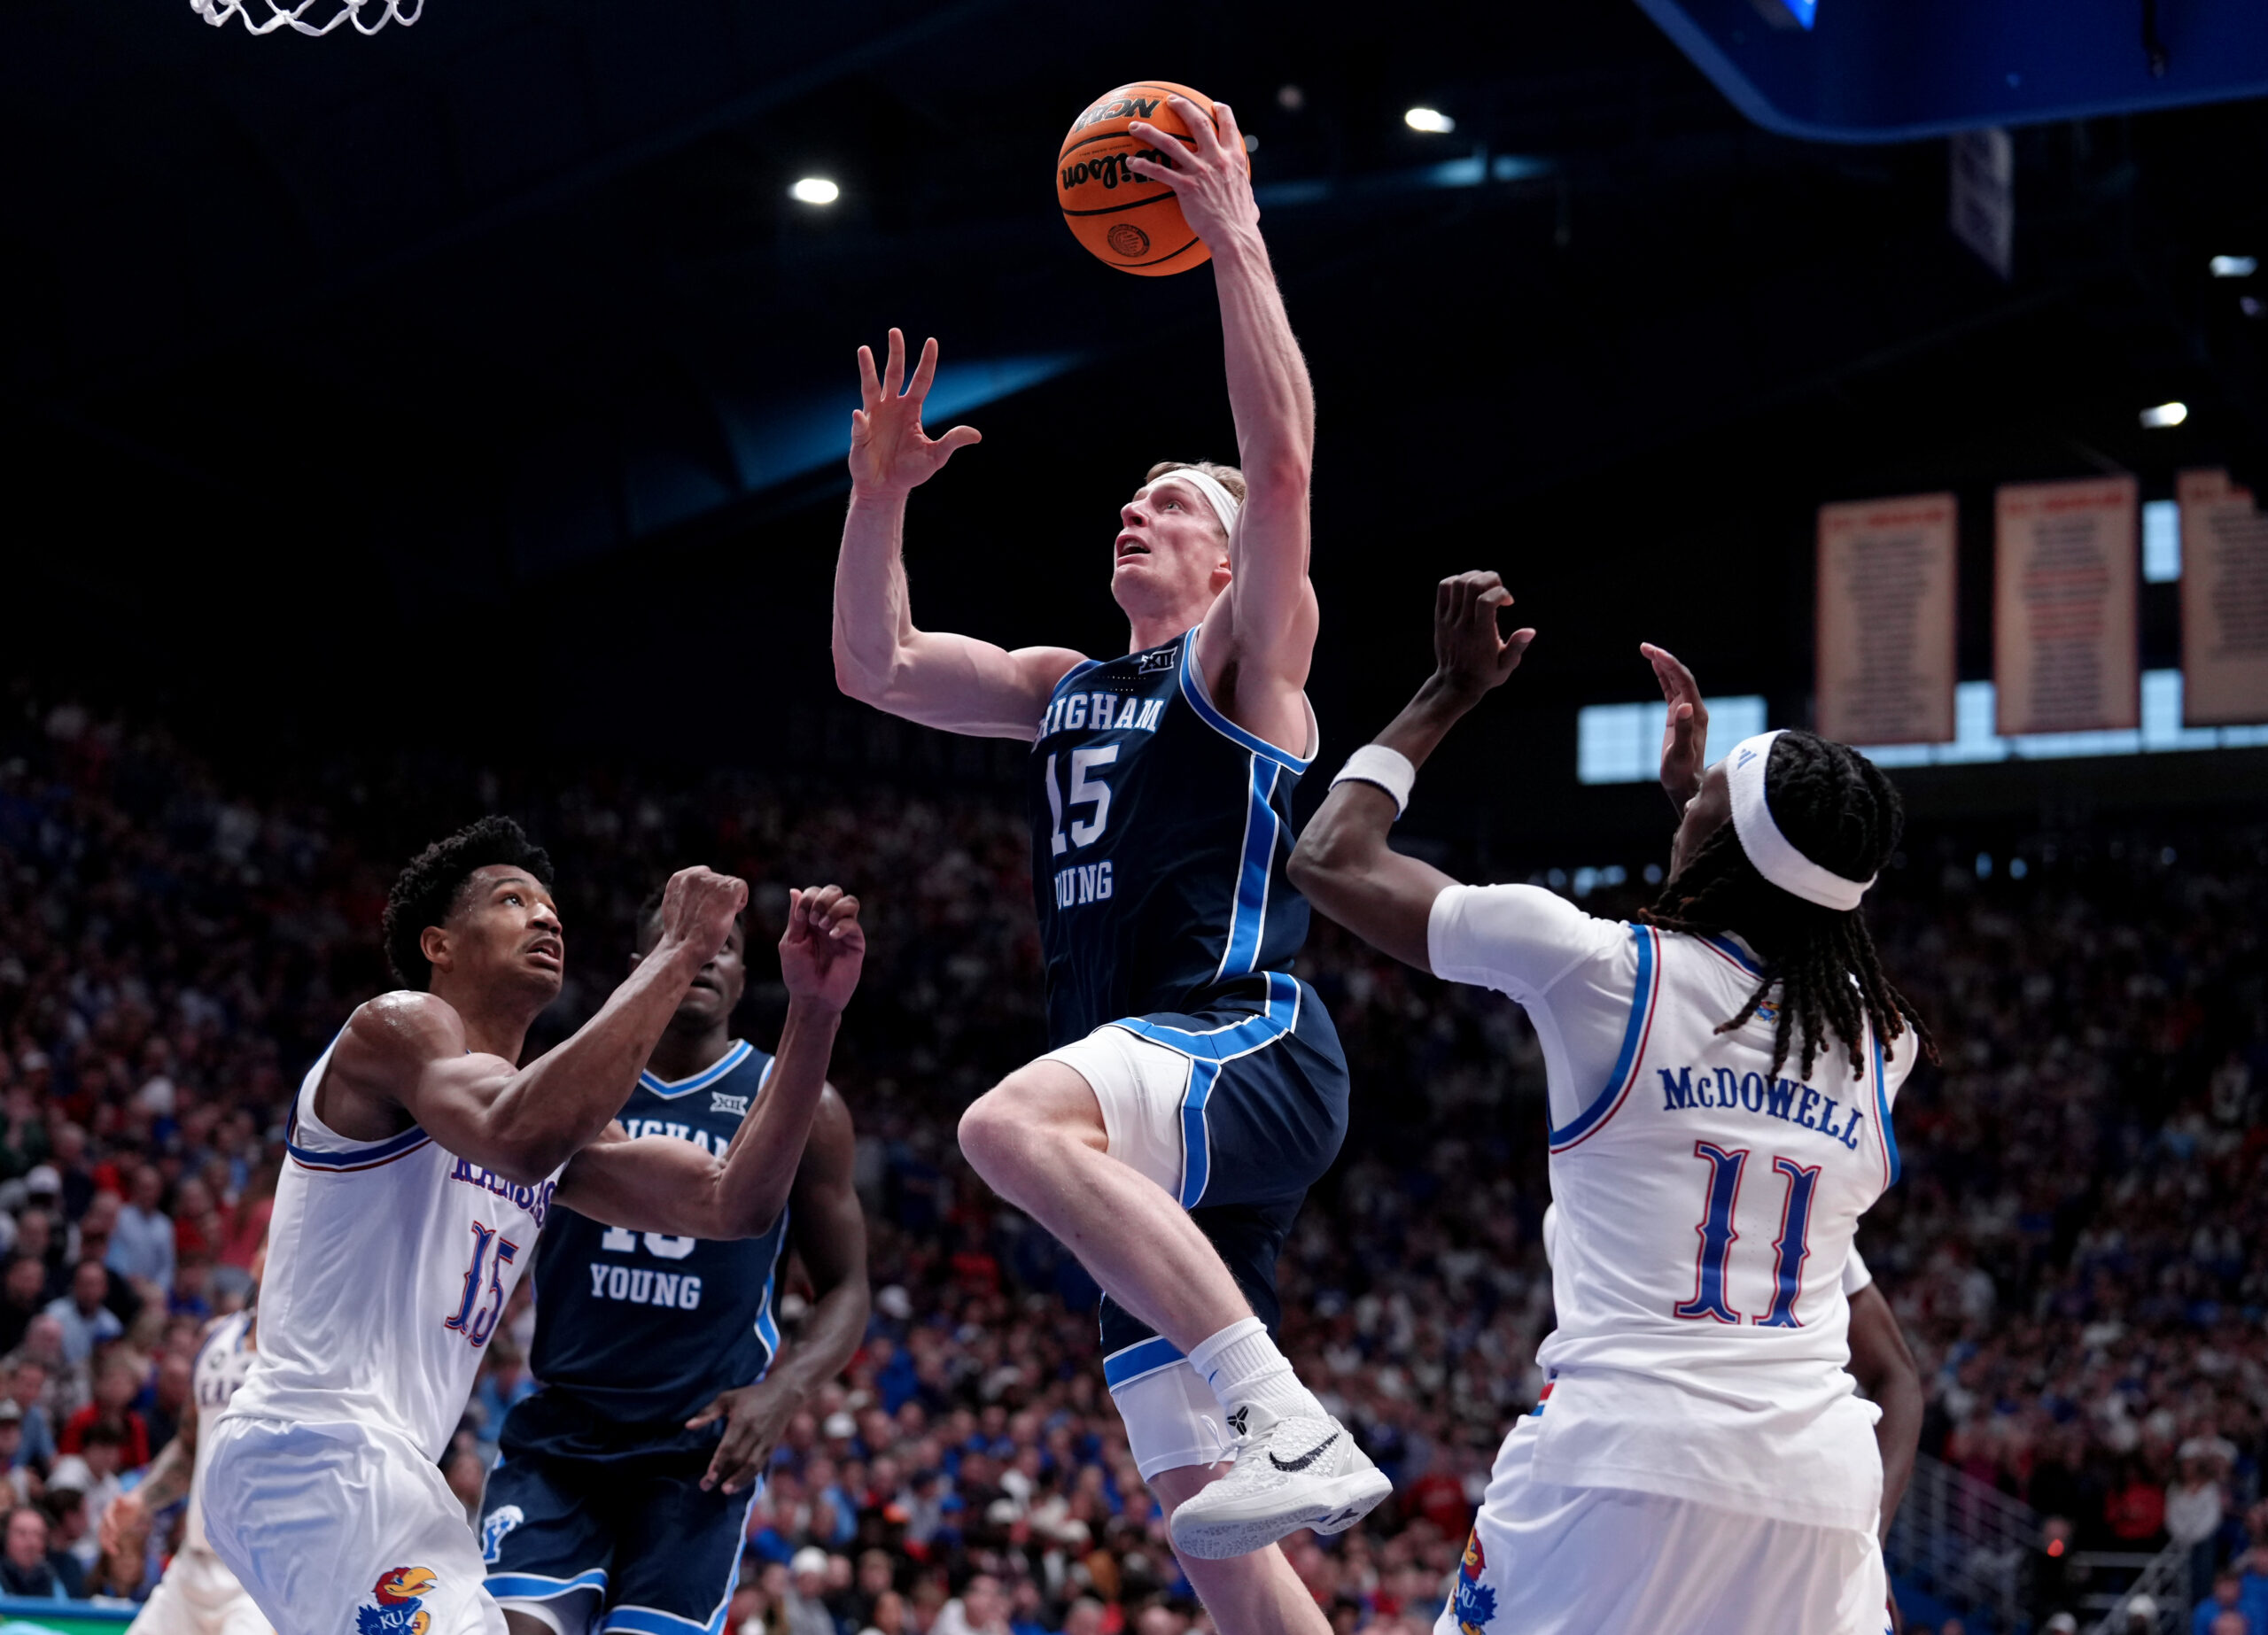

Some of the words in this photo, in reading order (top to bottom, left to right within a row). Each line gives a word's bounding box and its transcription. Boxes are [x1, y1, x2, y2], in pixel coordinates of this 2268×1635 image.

[1030, 694, 1164, 753] RIGHAM
[1045, 744, 1120, 856] 15
[1054, 861, 1113, 910] UNG
[1657, 1065, 1863, 1151] McDOWELL
[1674, 1139, 1821, 1329] 11
[444, 1220, 520, 1348] 15
[590, 1262, 702, 1310] YOUNG
[379, 1610, 405, 1630] KU
